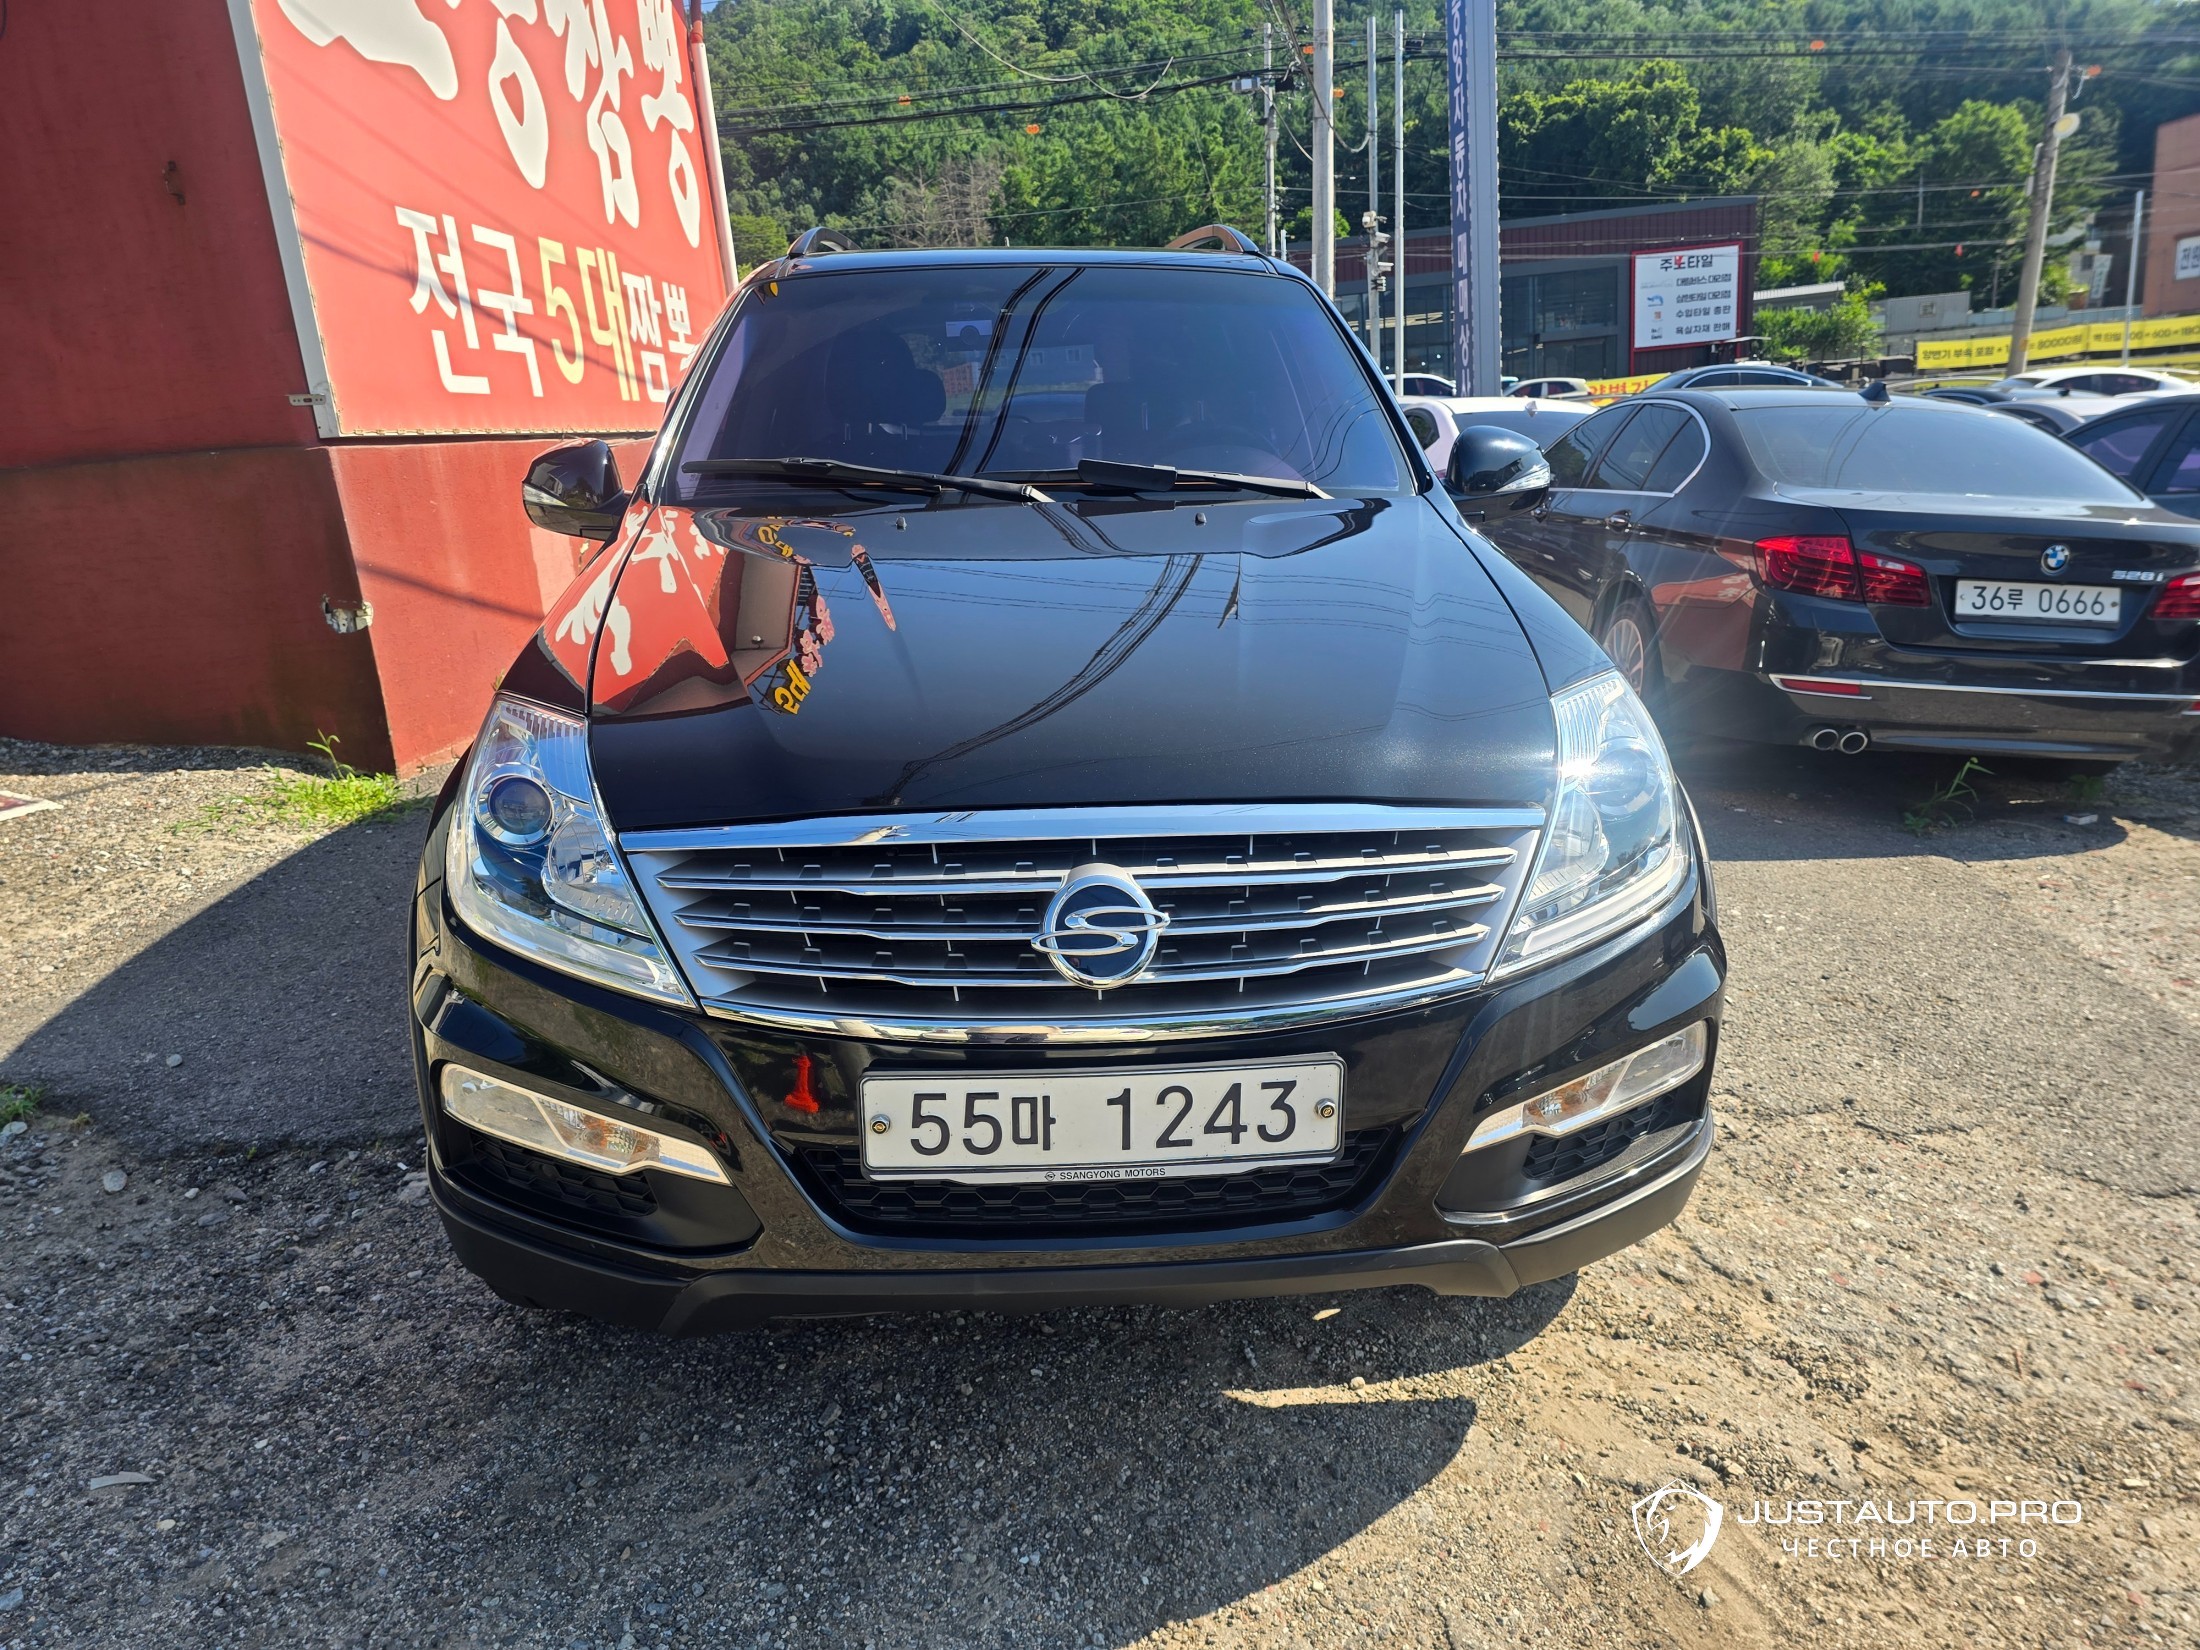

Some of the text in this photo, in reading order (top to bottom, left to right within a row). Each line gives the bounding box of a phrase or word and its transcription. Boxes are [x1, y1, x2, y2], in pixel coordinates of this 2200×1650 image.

[1971, 585, 2105, 616] 36루 0666
[909, 1079, 1298, 1157] 55마 1243
[1059, 1167, 1166, 1181] SSANGYONG MOTORS
